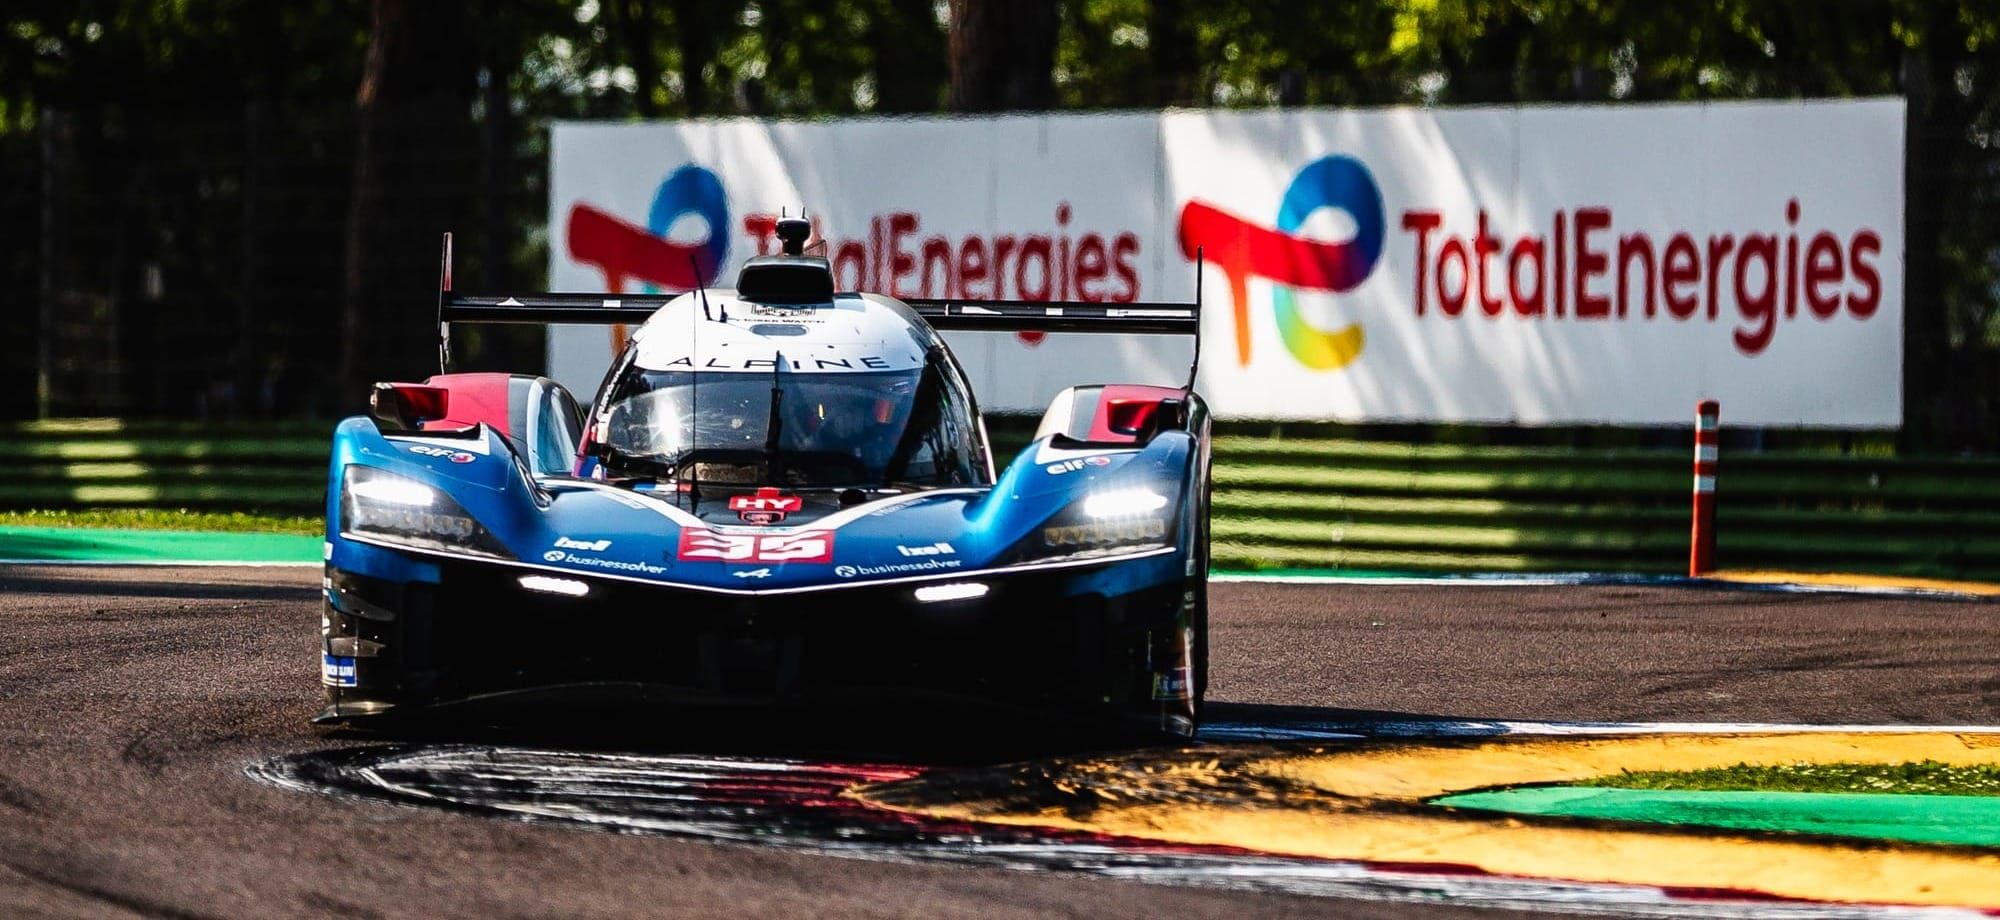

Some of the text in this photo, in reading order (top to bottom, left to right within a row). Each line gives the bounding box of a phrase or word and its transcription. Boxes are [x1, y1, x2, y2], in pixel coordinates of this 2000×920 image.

[743, 201, 1141, 345] TalEnergies
[1401, 197, 1883, 356] TotalEnergies
[666, 356, 890, 370] ALPINE
[736, 498, 796, 509] HY
[683, 529, 830, 561] 35
[565, 553, 668, 575] businessolver
[857, 559, 962, 576] businessolver
